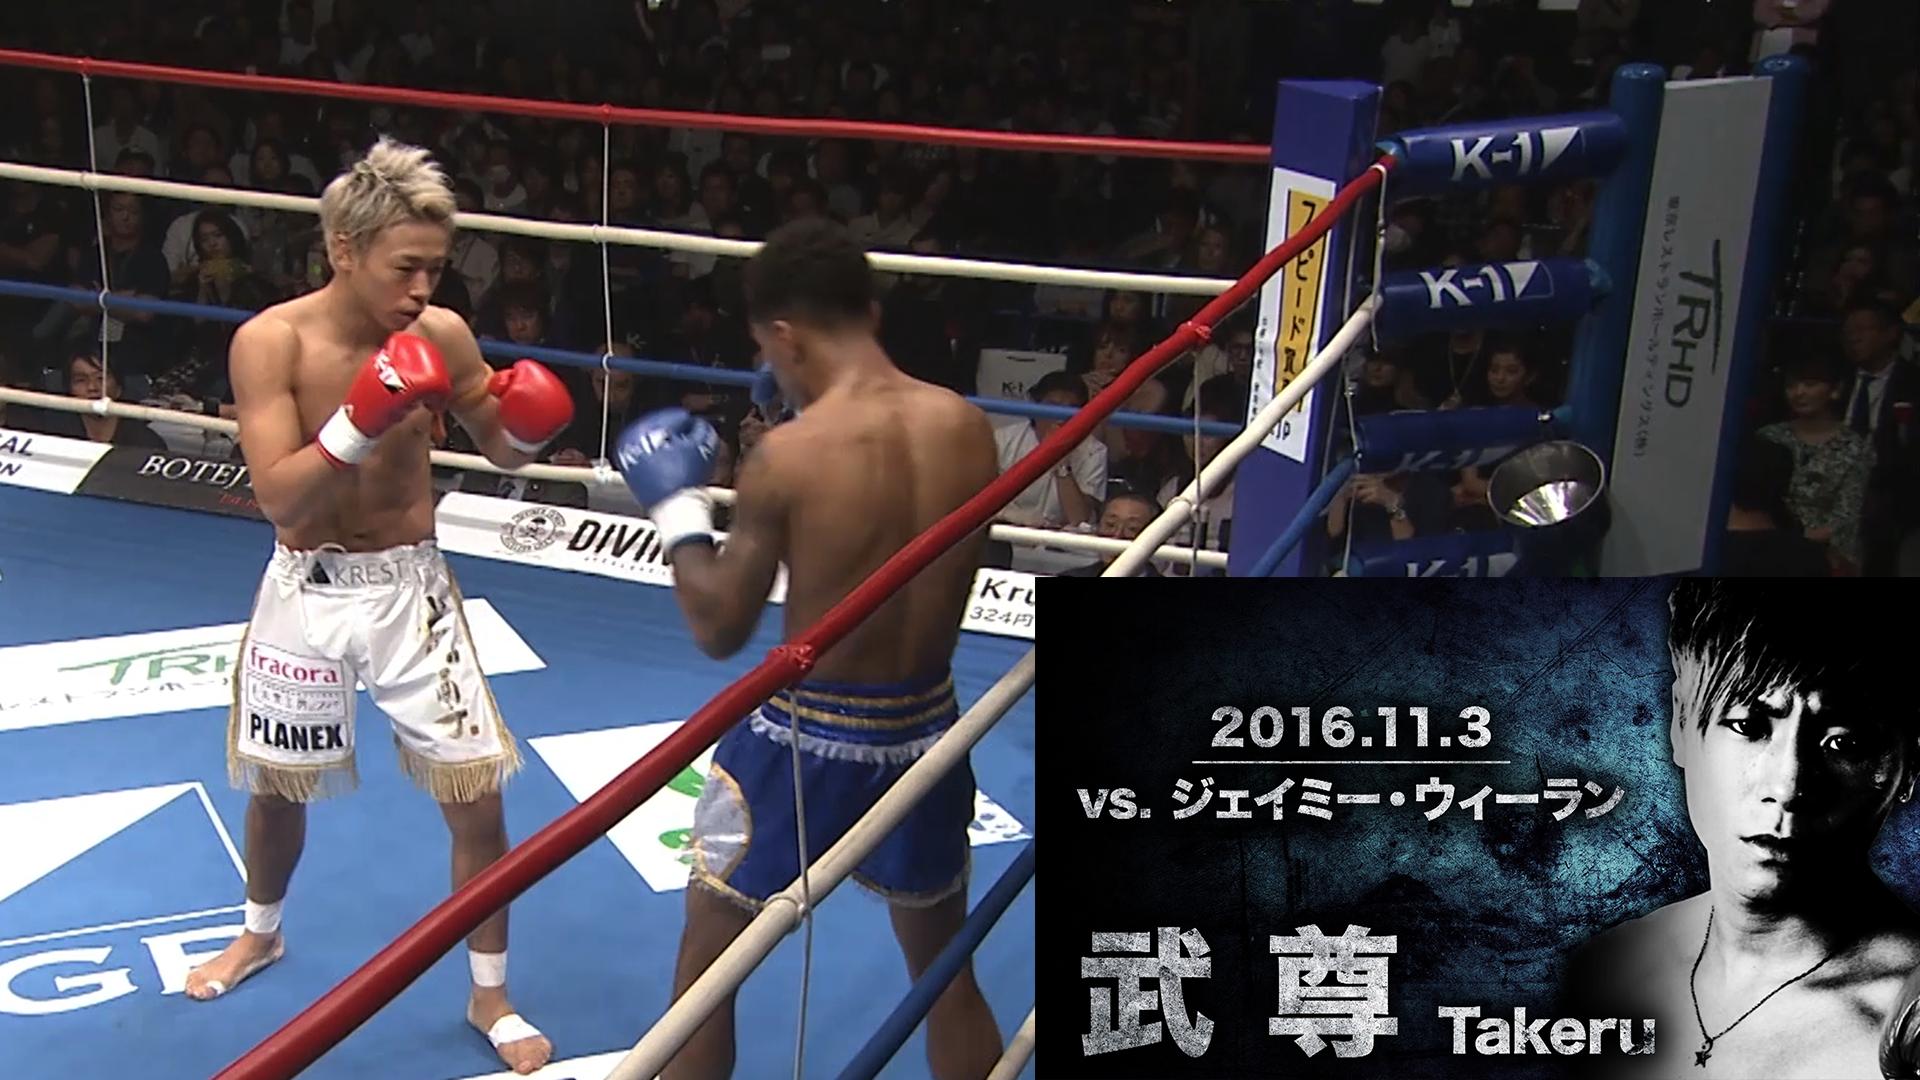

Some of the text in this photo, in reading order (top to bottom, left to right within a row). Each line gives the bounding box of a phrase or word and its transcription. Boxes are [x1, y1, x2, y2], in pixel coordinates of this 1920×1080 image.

[1451, 131, 1533, 182] K-1
[1419, 264, 1506, 309] K-1
[1664, 239, 1724, 409] TRHD
[0, 433, 33, 457] AL
[139, 454, 252, 490] BOTEJ
[334, 560, 406, 586] KREST
[251, 646, 339, 684] fracora
[250, 713, 344, 752] PLANEX
